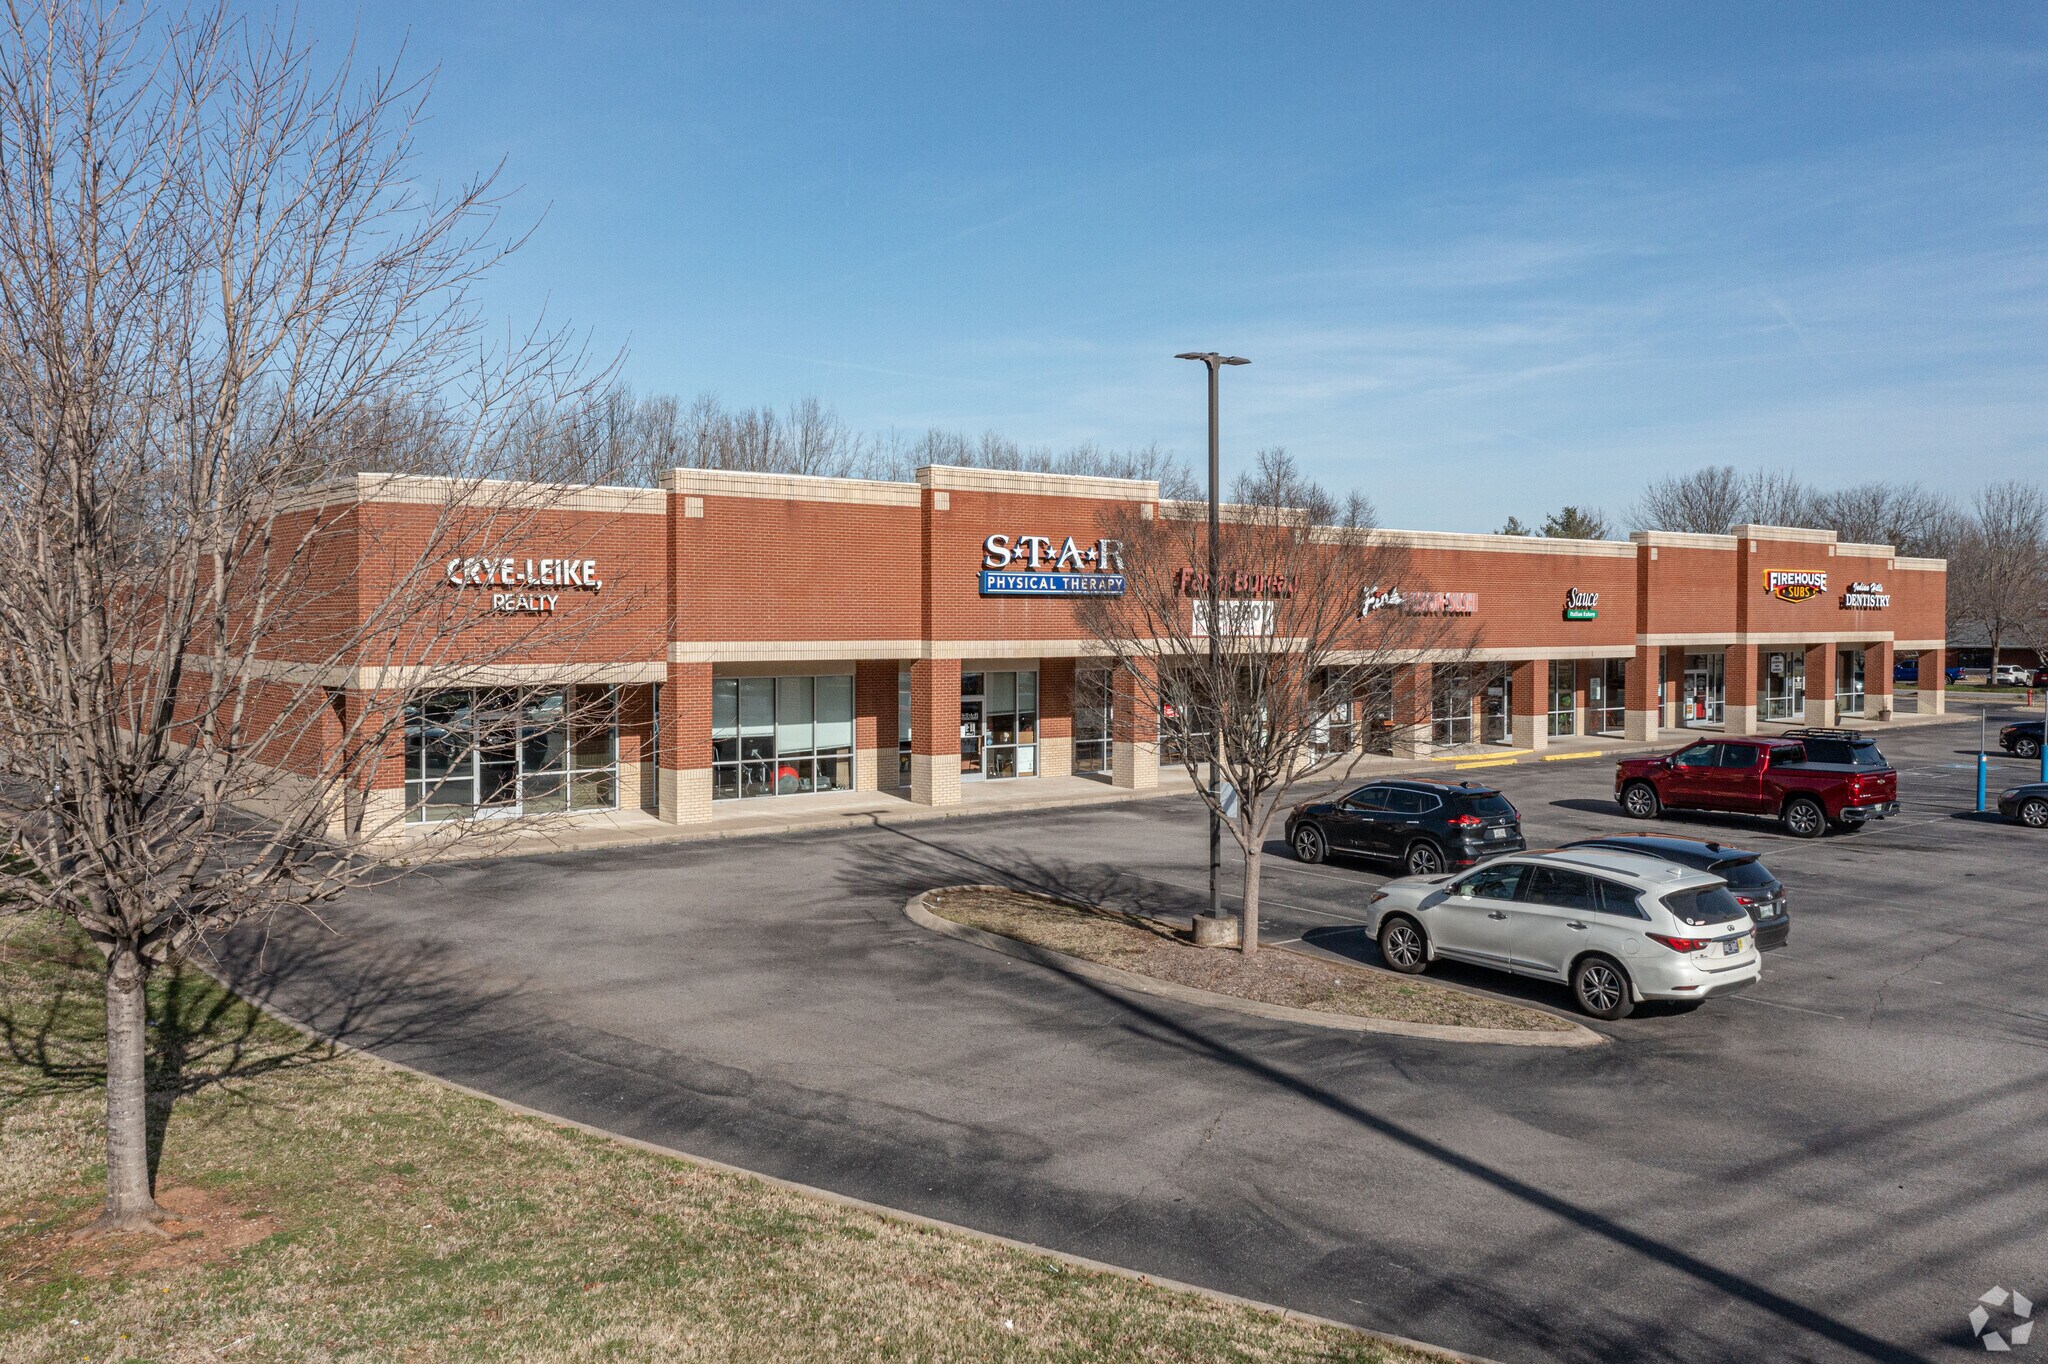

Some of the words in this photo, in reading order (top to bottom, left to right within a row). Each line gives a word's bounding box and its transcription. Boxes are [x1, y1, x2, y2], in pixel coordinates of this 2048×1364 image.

[987, 576, 1057, 589] PHYSICAL
[1062, 577, 1123, 590] THERAPY
[1770, 572, 1827, 591] FIREHOUSE
[1568, 587, 1599, 608] Sauce
[1788, 586, 1810, 597] SUBS
[493, 593, 559, 611] REALTY
[1846, 593, 1890, 607] DENTISTRY
